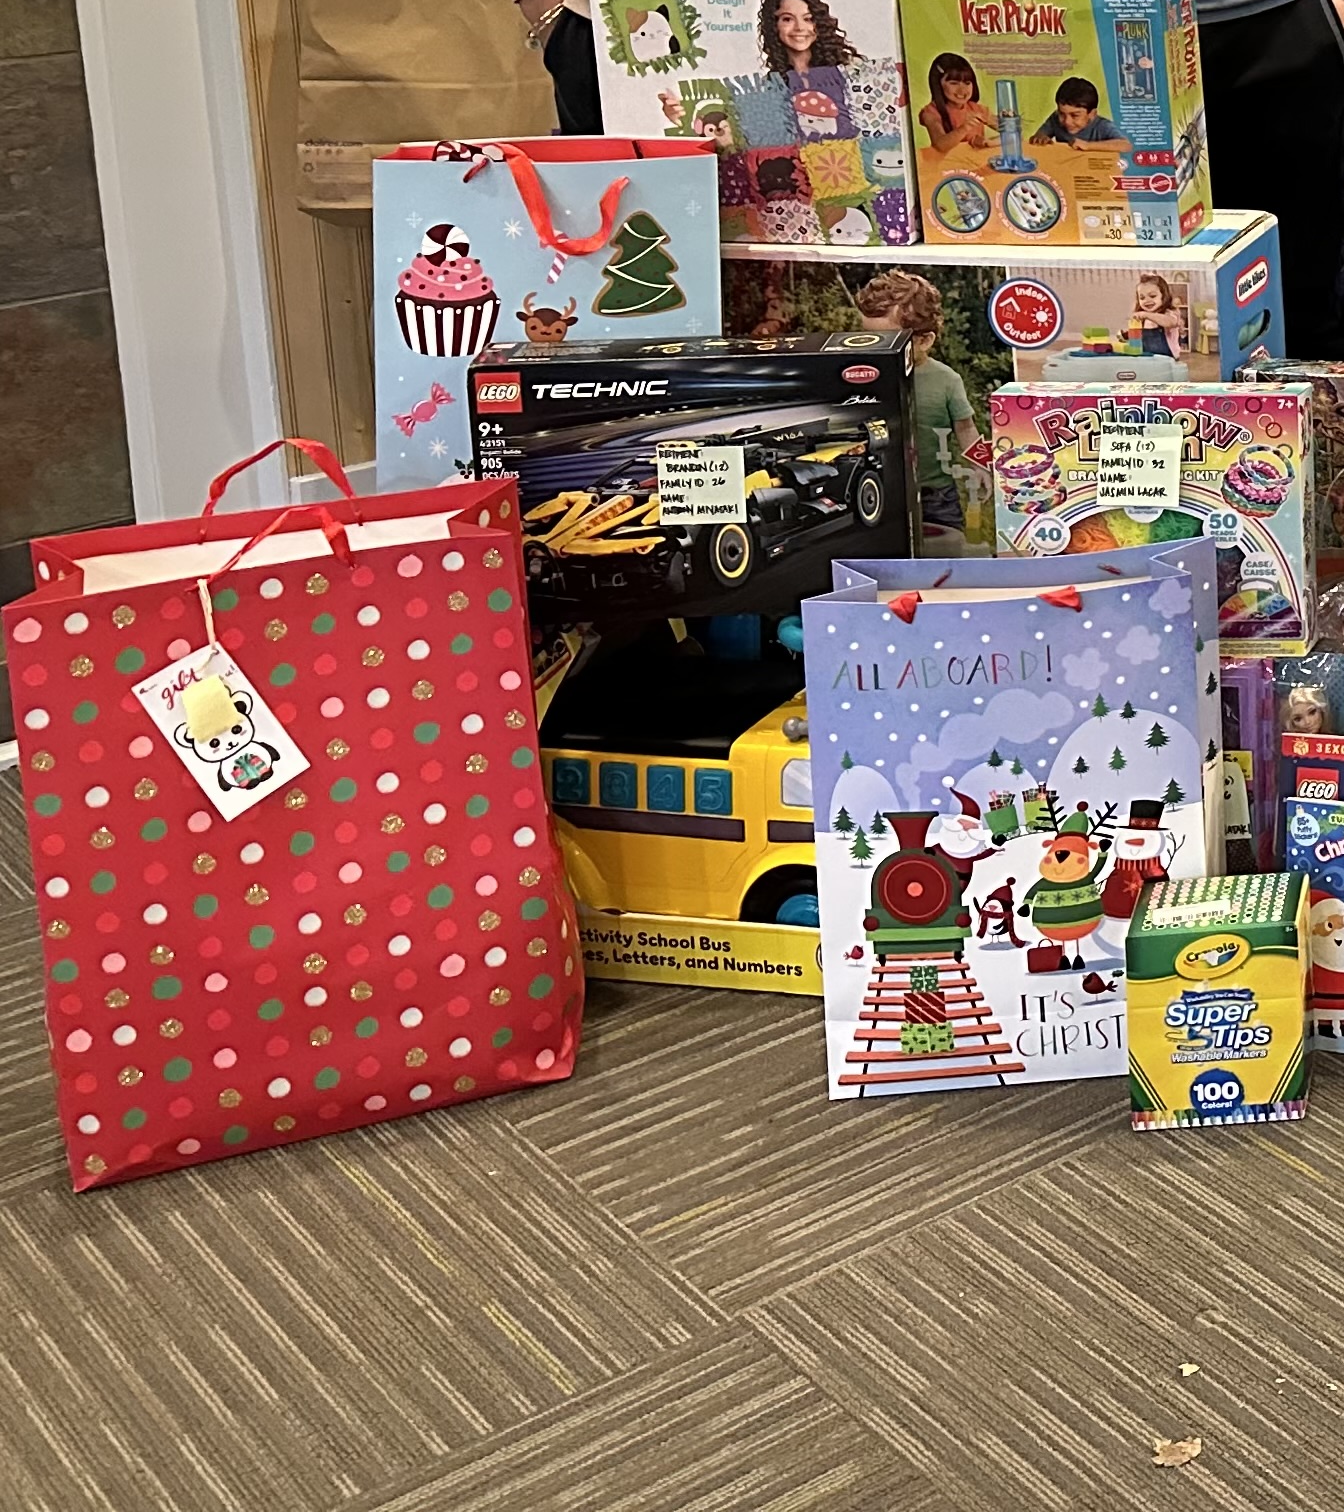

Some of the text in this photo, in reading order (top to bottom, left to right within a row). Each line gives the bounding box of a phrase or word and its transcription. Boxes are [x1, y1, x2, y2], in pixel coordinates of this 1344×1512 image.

[723, 8, 732, 18] It
[704, 21, 752, 32] Yourself!
[1014, 286, 1048, 304] Indoor
[1004, 322, 1042, 340] Outdoor
[477, 380, 669, 401] LEGO TECHNIC
[1278, 399, 1294, 410] 7+
[478, 422, 503, 436] 9+
[481, 458, 502, 469] 905
[1152, 460, 1165, 469] 32
[712, 478, 726, 486] 26
[1195, 470, 1218, 482] KIT
[1100, 487, 1168, 497] JASMIN LACAR
[1209, 514, 1238, 530] 50
[1034, 528, 1062, 541] 40
[1246, 561, 1273, 569] CASE/
[832, 645, 1053, 691] ALL ABOARD!
[1316, 743, 1323, 753] 3
[699, 776, 724, 811] 5
[1299, 781, 1338, 799] LEGO
[637, 932, 731, 952] School Bus
[612, 948, 802, 976] Letters, and Numbers
[1018, 990, 1075, 1021] IT'S
[1166, 1003, 1256, 1028] Super
[1015, 1014, 1127, 1059] CHRIST
[1212, 1026, 1270, 1049] Tips
[1172, 1049, 1267, 1063] Washable Markers
[1194, 1082, 1239, 1102] 100
[1202, 1101, 1232, 1109] Colors!
